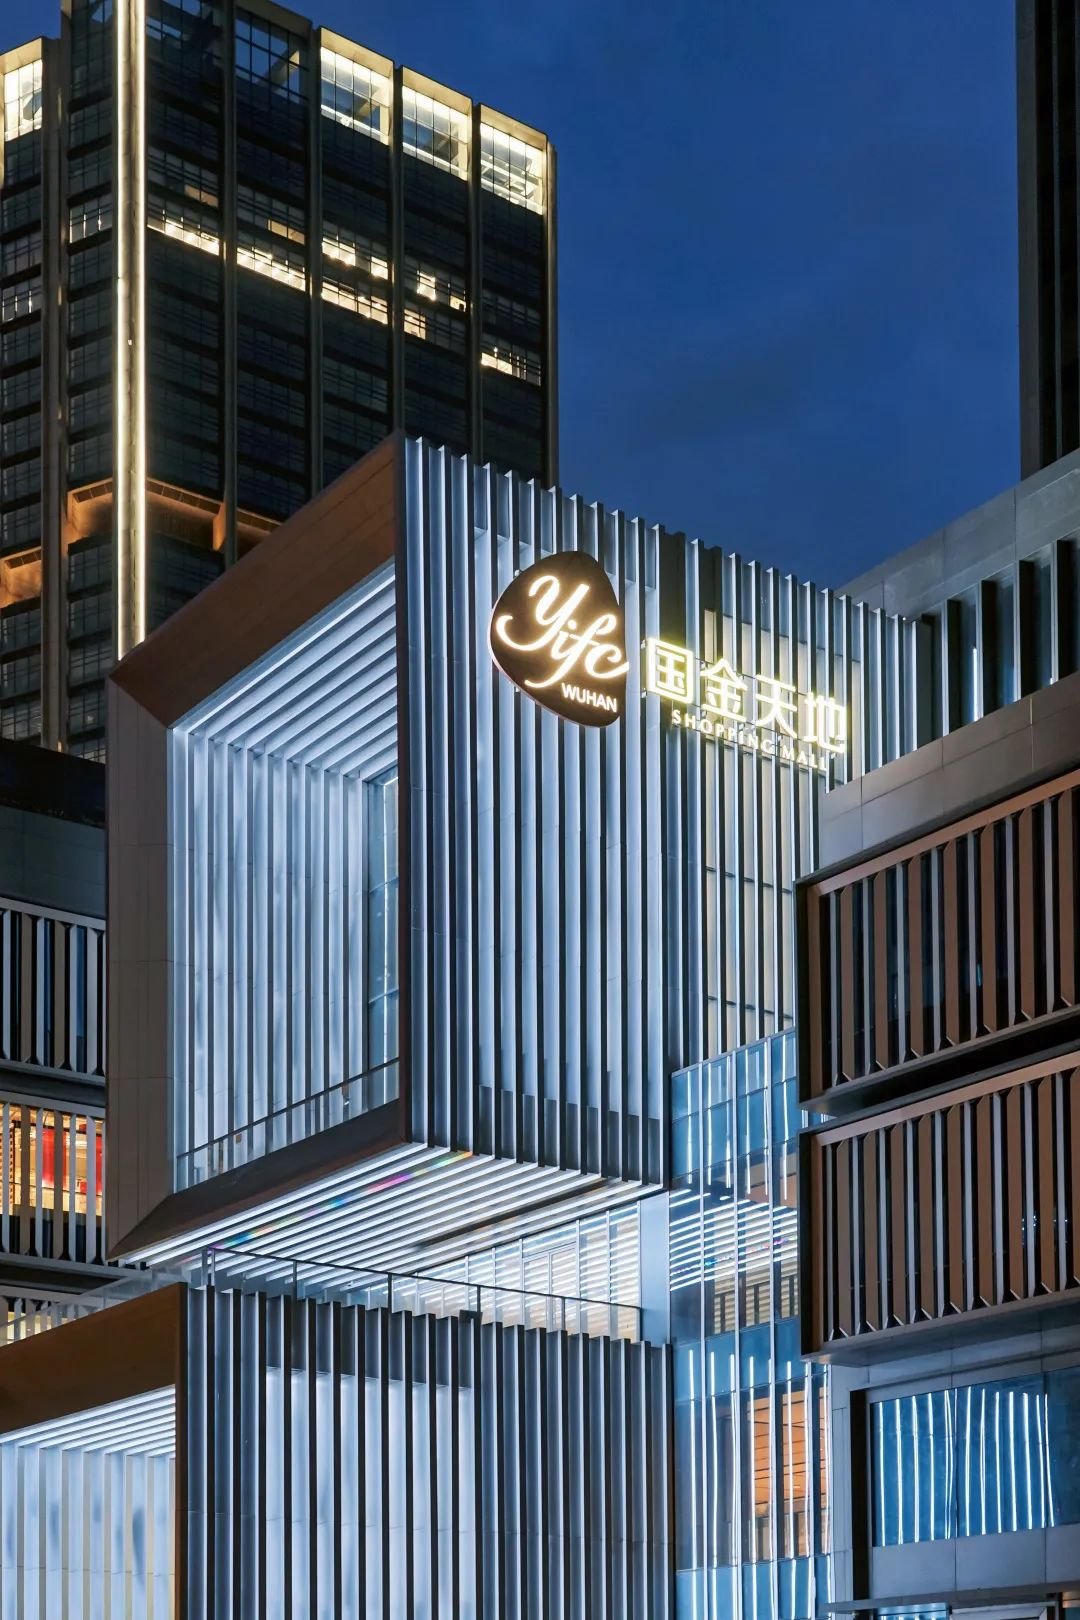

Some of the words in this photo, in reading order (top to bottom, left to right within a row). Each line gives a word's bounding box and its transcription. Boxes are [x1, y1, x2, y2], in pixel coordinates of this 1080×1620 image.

[562, 682, 617, 712] WUHAN
[647, 637, 847, 754] 国金天地
[671, 709, 776, 755] SHOPPING
[782, 744, 828, 772] MALL
